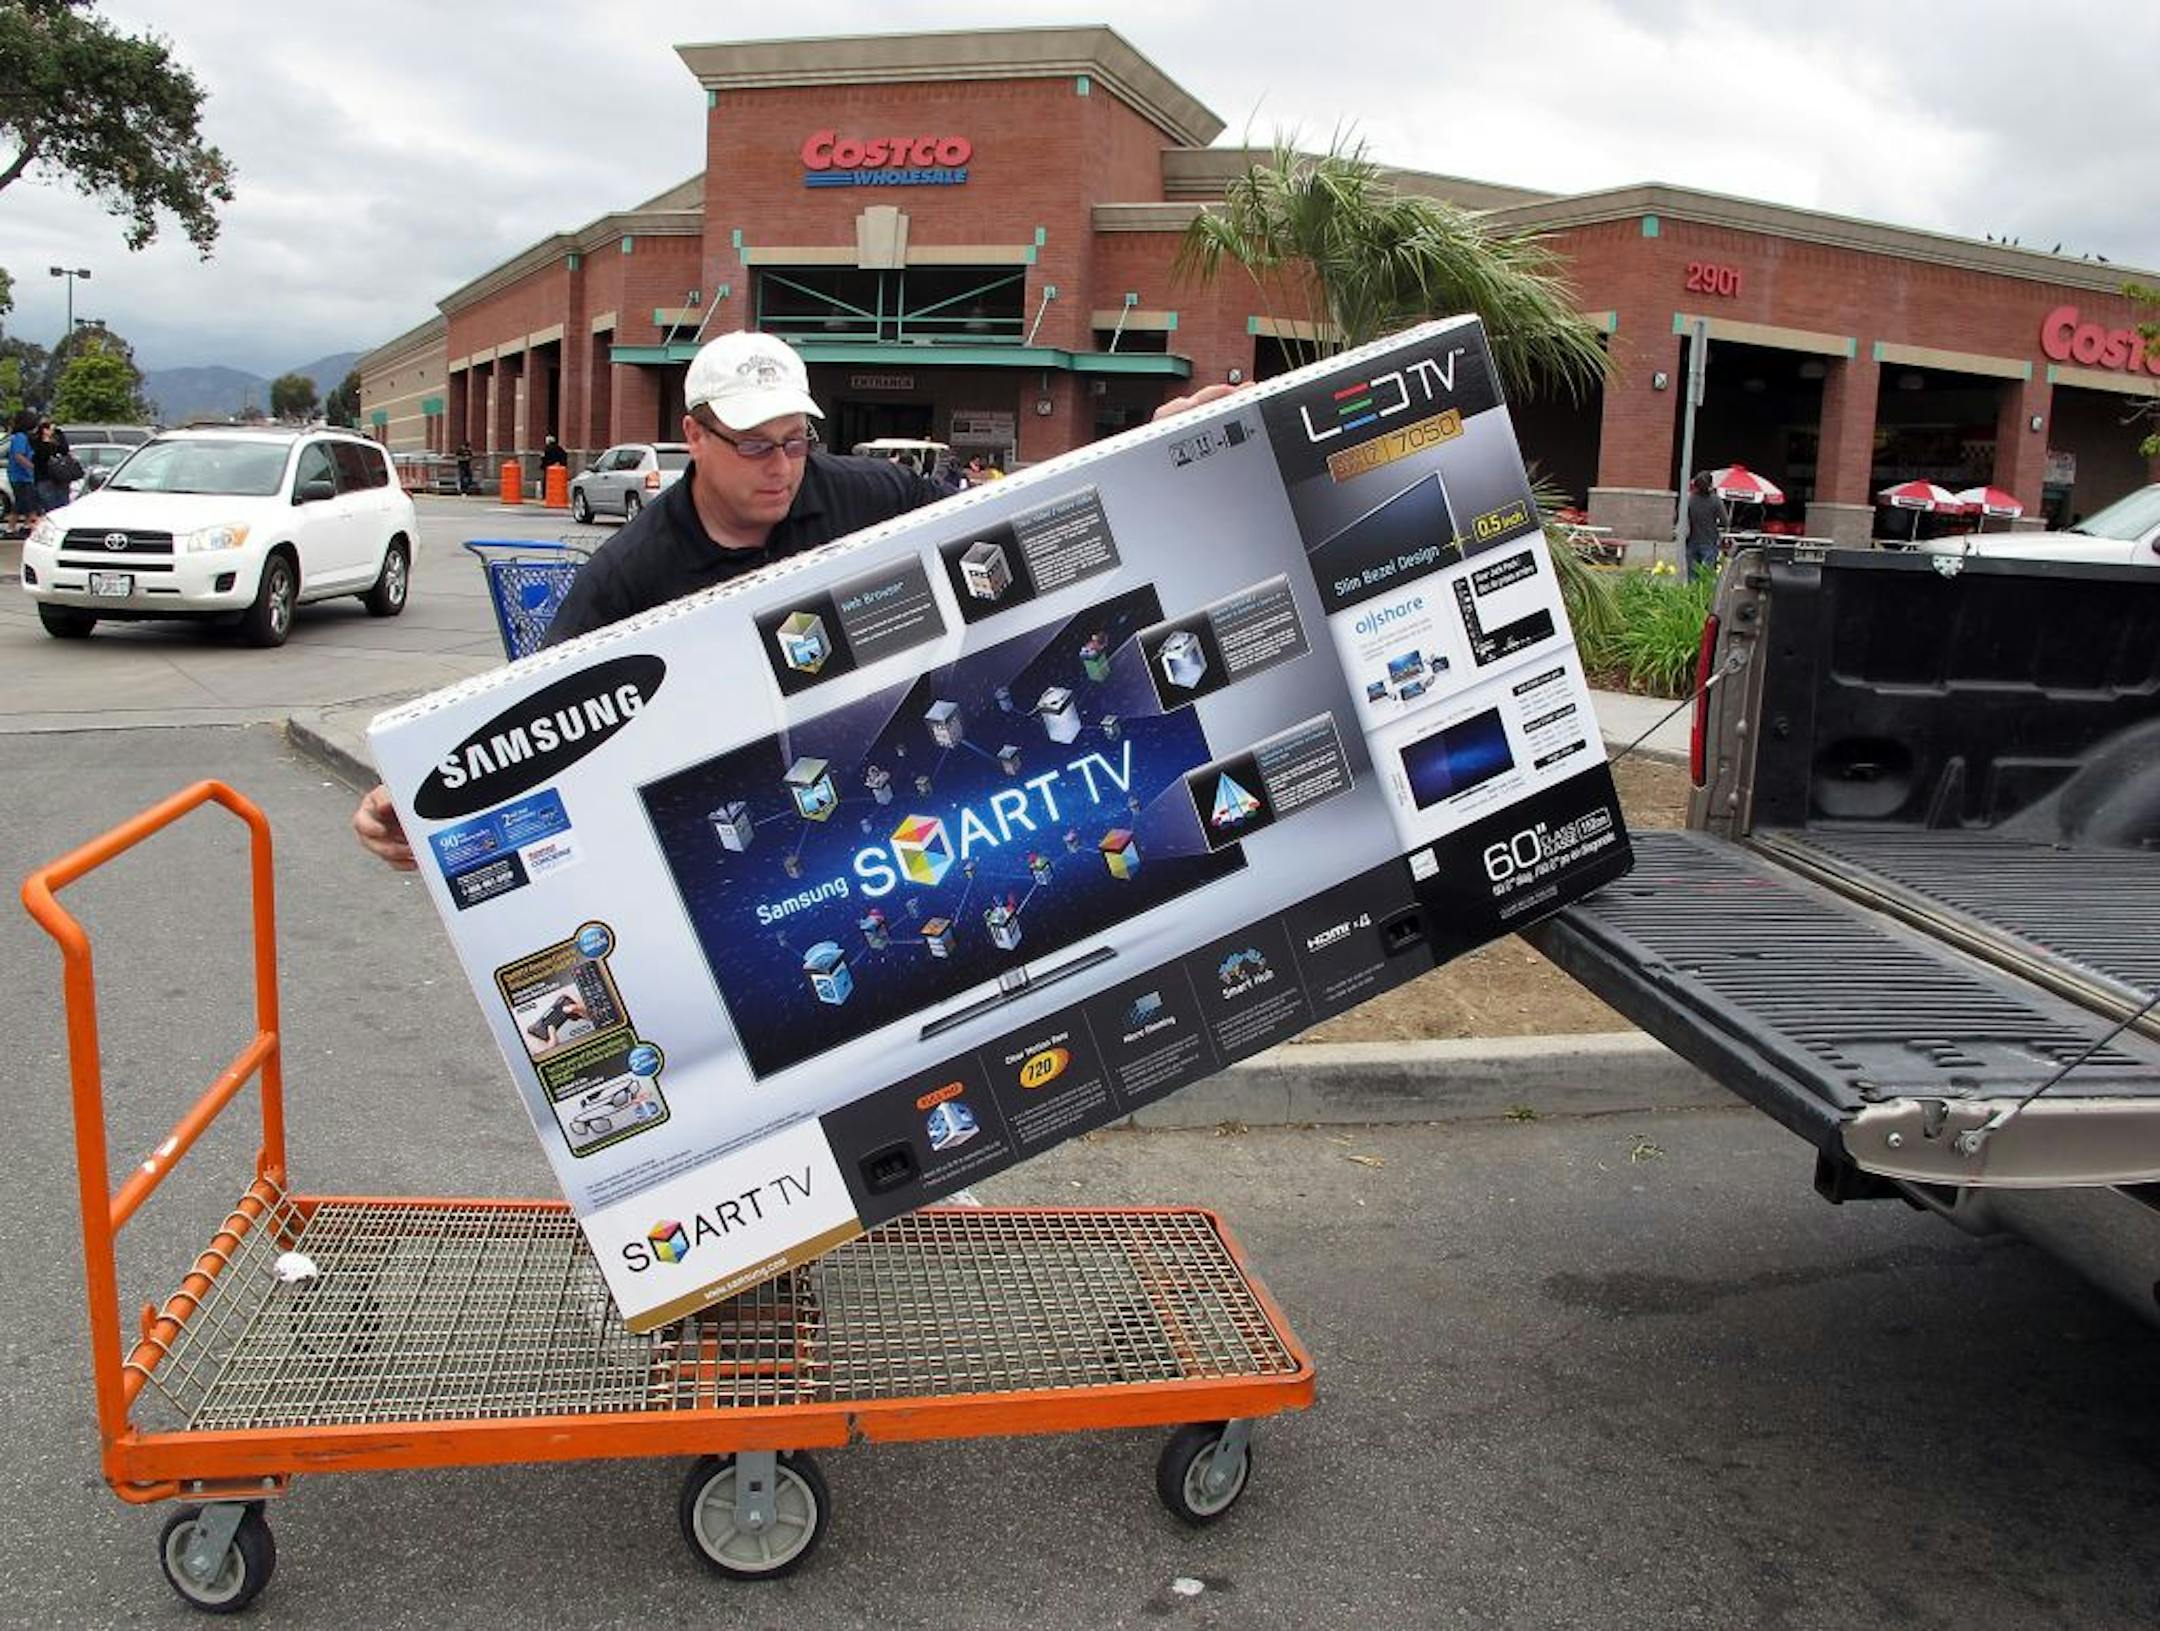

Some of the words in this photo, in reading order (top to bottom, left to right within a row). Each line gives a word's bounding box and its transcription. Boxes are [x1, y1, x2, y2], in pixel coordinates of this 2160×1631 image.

[802, 129, 972, 170] COSTCO
[854, 169, 968, 185] WHOLESALE
[1686, 262, 1742, 297] 2901
[1391, 415, 1456, 452] 7050
[1478, 514, 1502, 537] 0.5
[1334, 577, 1361, 597] Slim
[1361, 560, 1398, 585] Bezel
[1398, 545, 1441, 573] Design
[439, 683, 645, 789] SAMSUNG
[1066, 739, 1132, 804] TV
[756, 874, 850, 926] Samsung
[1027, 1057, 1051, 1081] 720
[768, 1166, 812, 1206] TV
